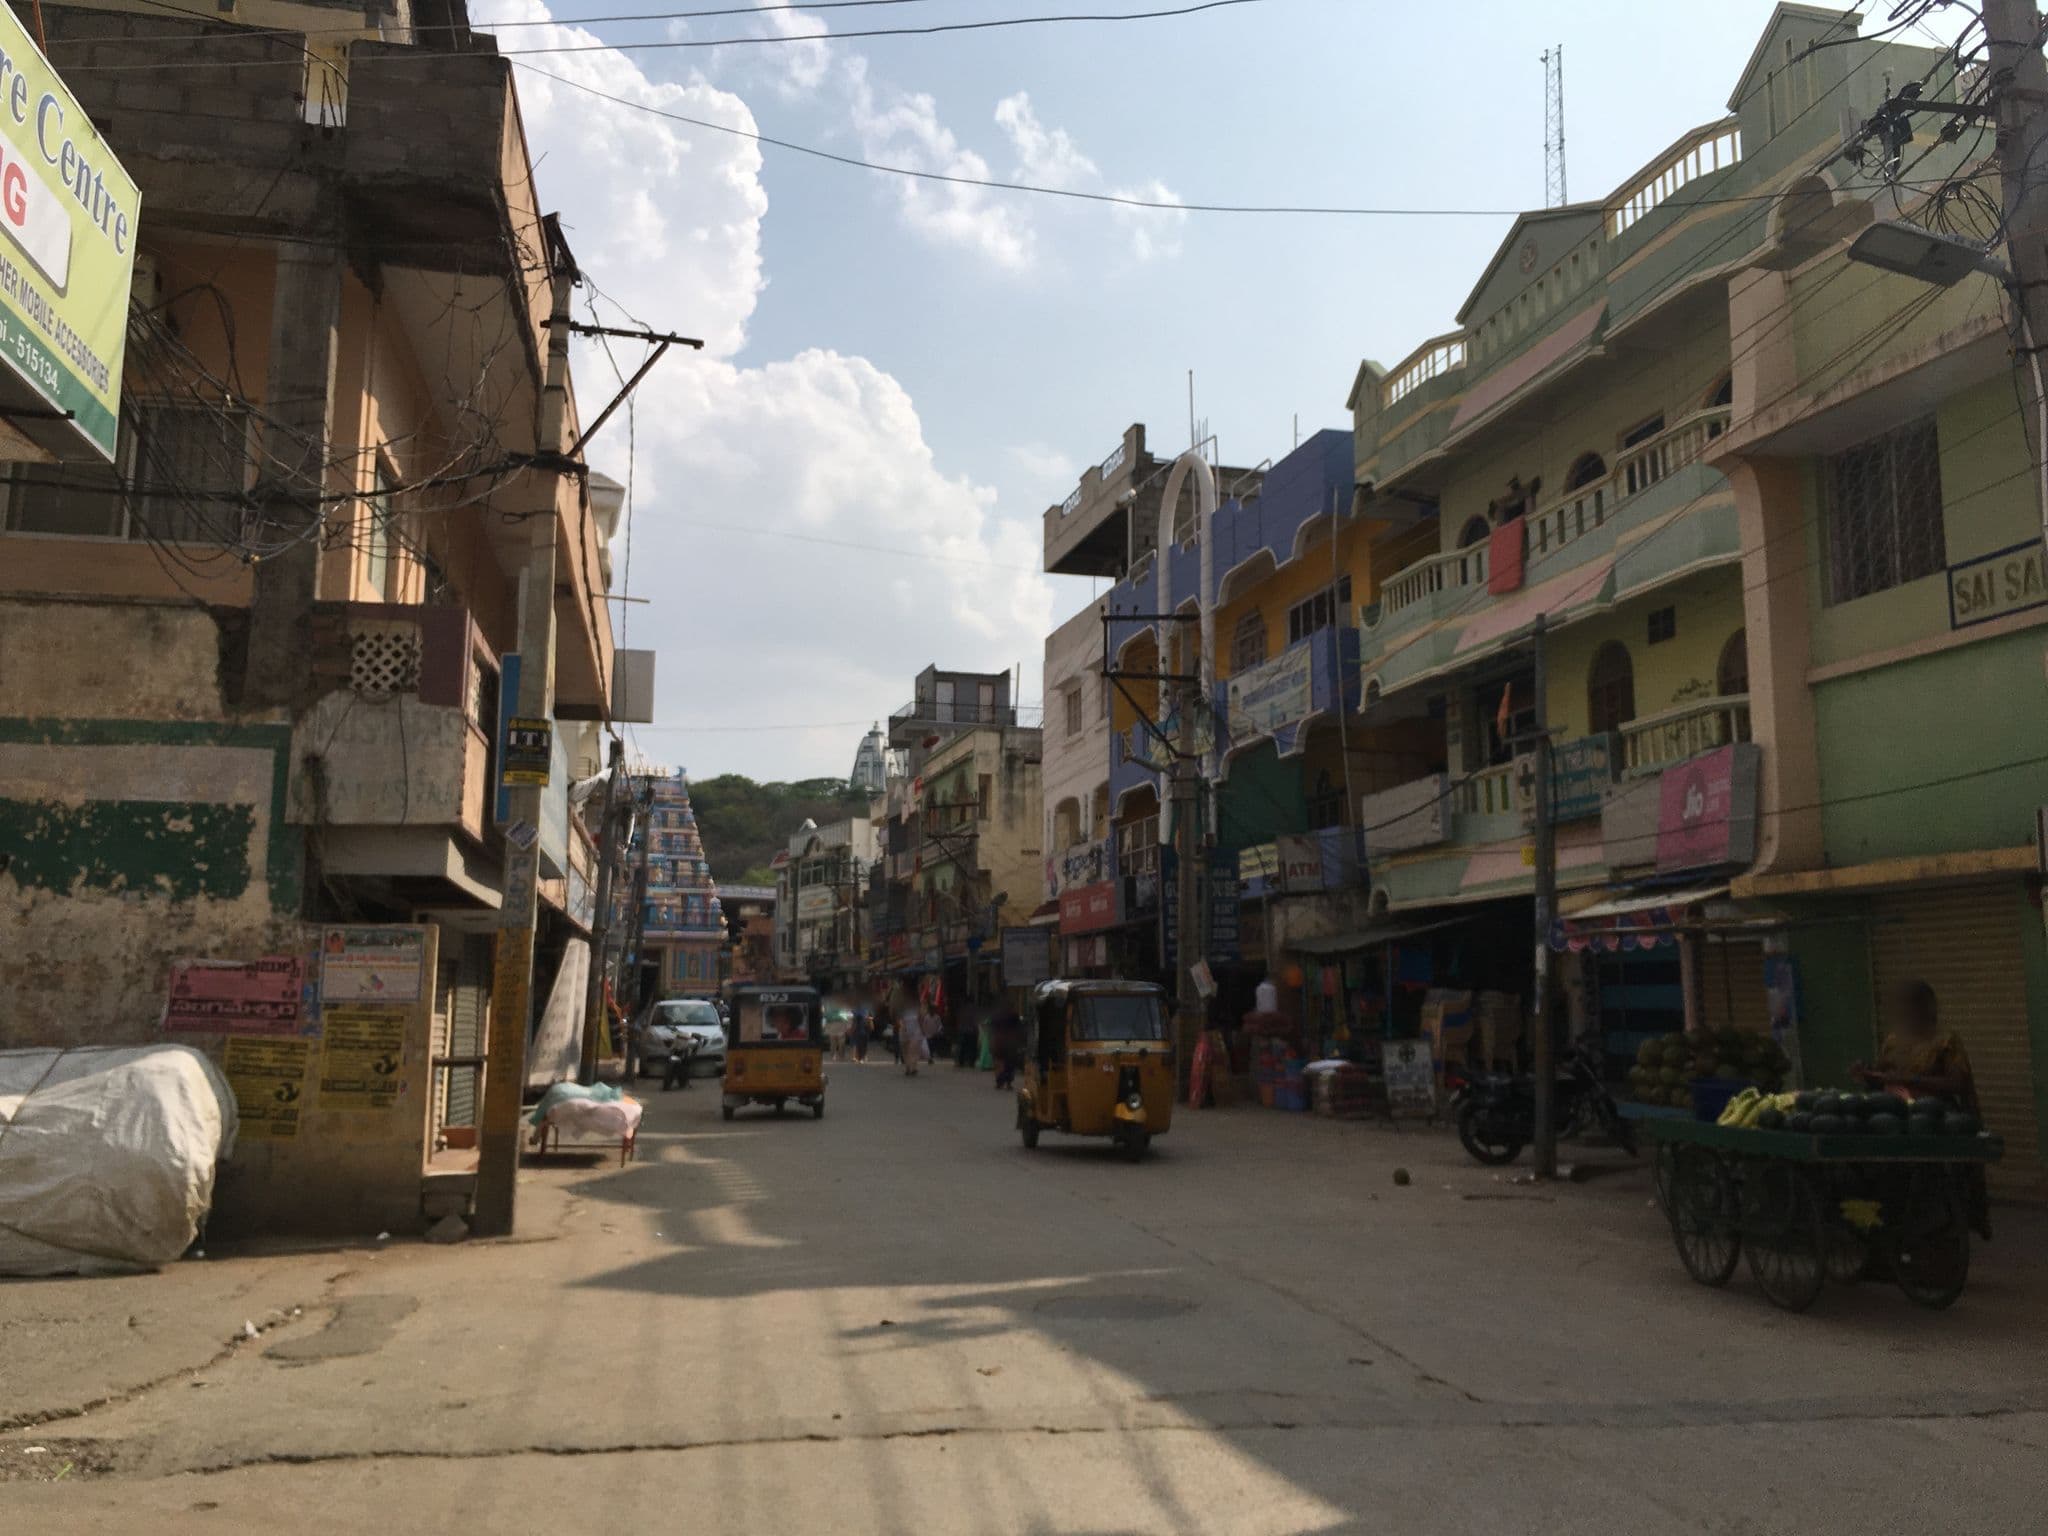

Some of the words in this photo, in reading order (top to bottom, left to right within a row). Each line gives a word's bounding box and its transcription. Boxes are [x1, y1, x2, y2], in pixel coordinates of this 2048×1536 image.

[0, 146, 27, 227] G
[37, 94, 128, 252] Centre
[16, 333, 62, 395] 515134.
[20, 276, 53, 338] MOBILE
[54, 317, 110, 395] ACCESSORIES
[1955, 568, 1995, 615] SAI
[1288, 863, 1320, 877] ATM
